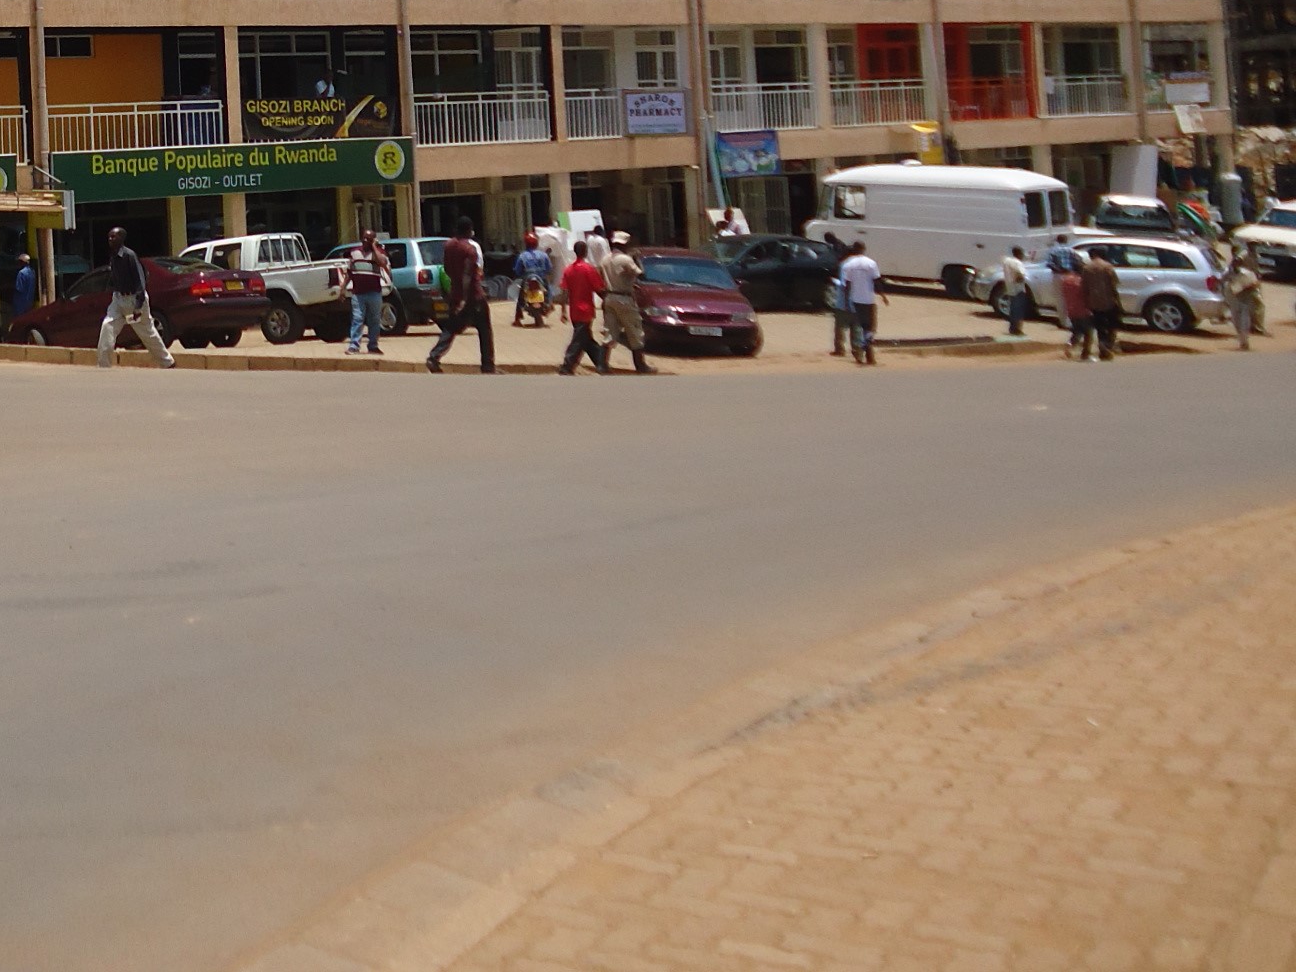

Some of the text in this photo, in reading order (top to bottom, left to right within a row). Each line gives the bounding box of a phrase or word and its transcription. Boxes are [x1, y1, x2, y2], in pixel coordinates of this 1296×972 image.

[246, 98, 346, 114] GISOZI BRANCH
[629, 108, 682, 117] PHARMACY
[261, 114, 334, 127] OPENING SOON
[92, 142, 337, 176] Banque Populaire du Rwanda
[177, 177, 212, 190] GISOZI
[223, 174, 263, 187] OUTLET
